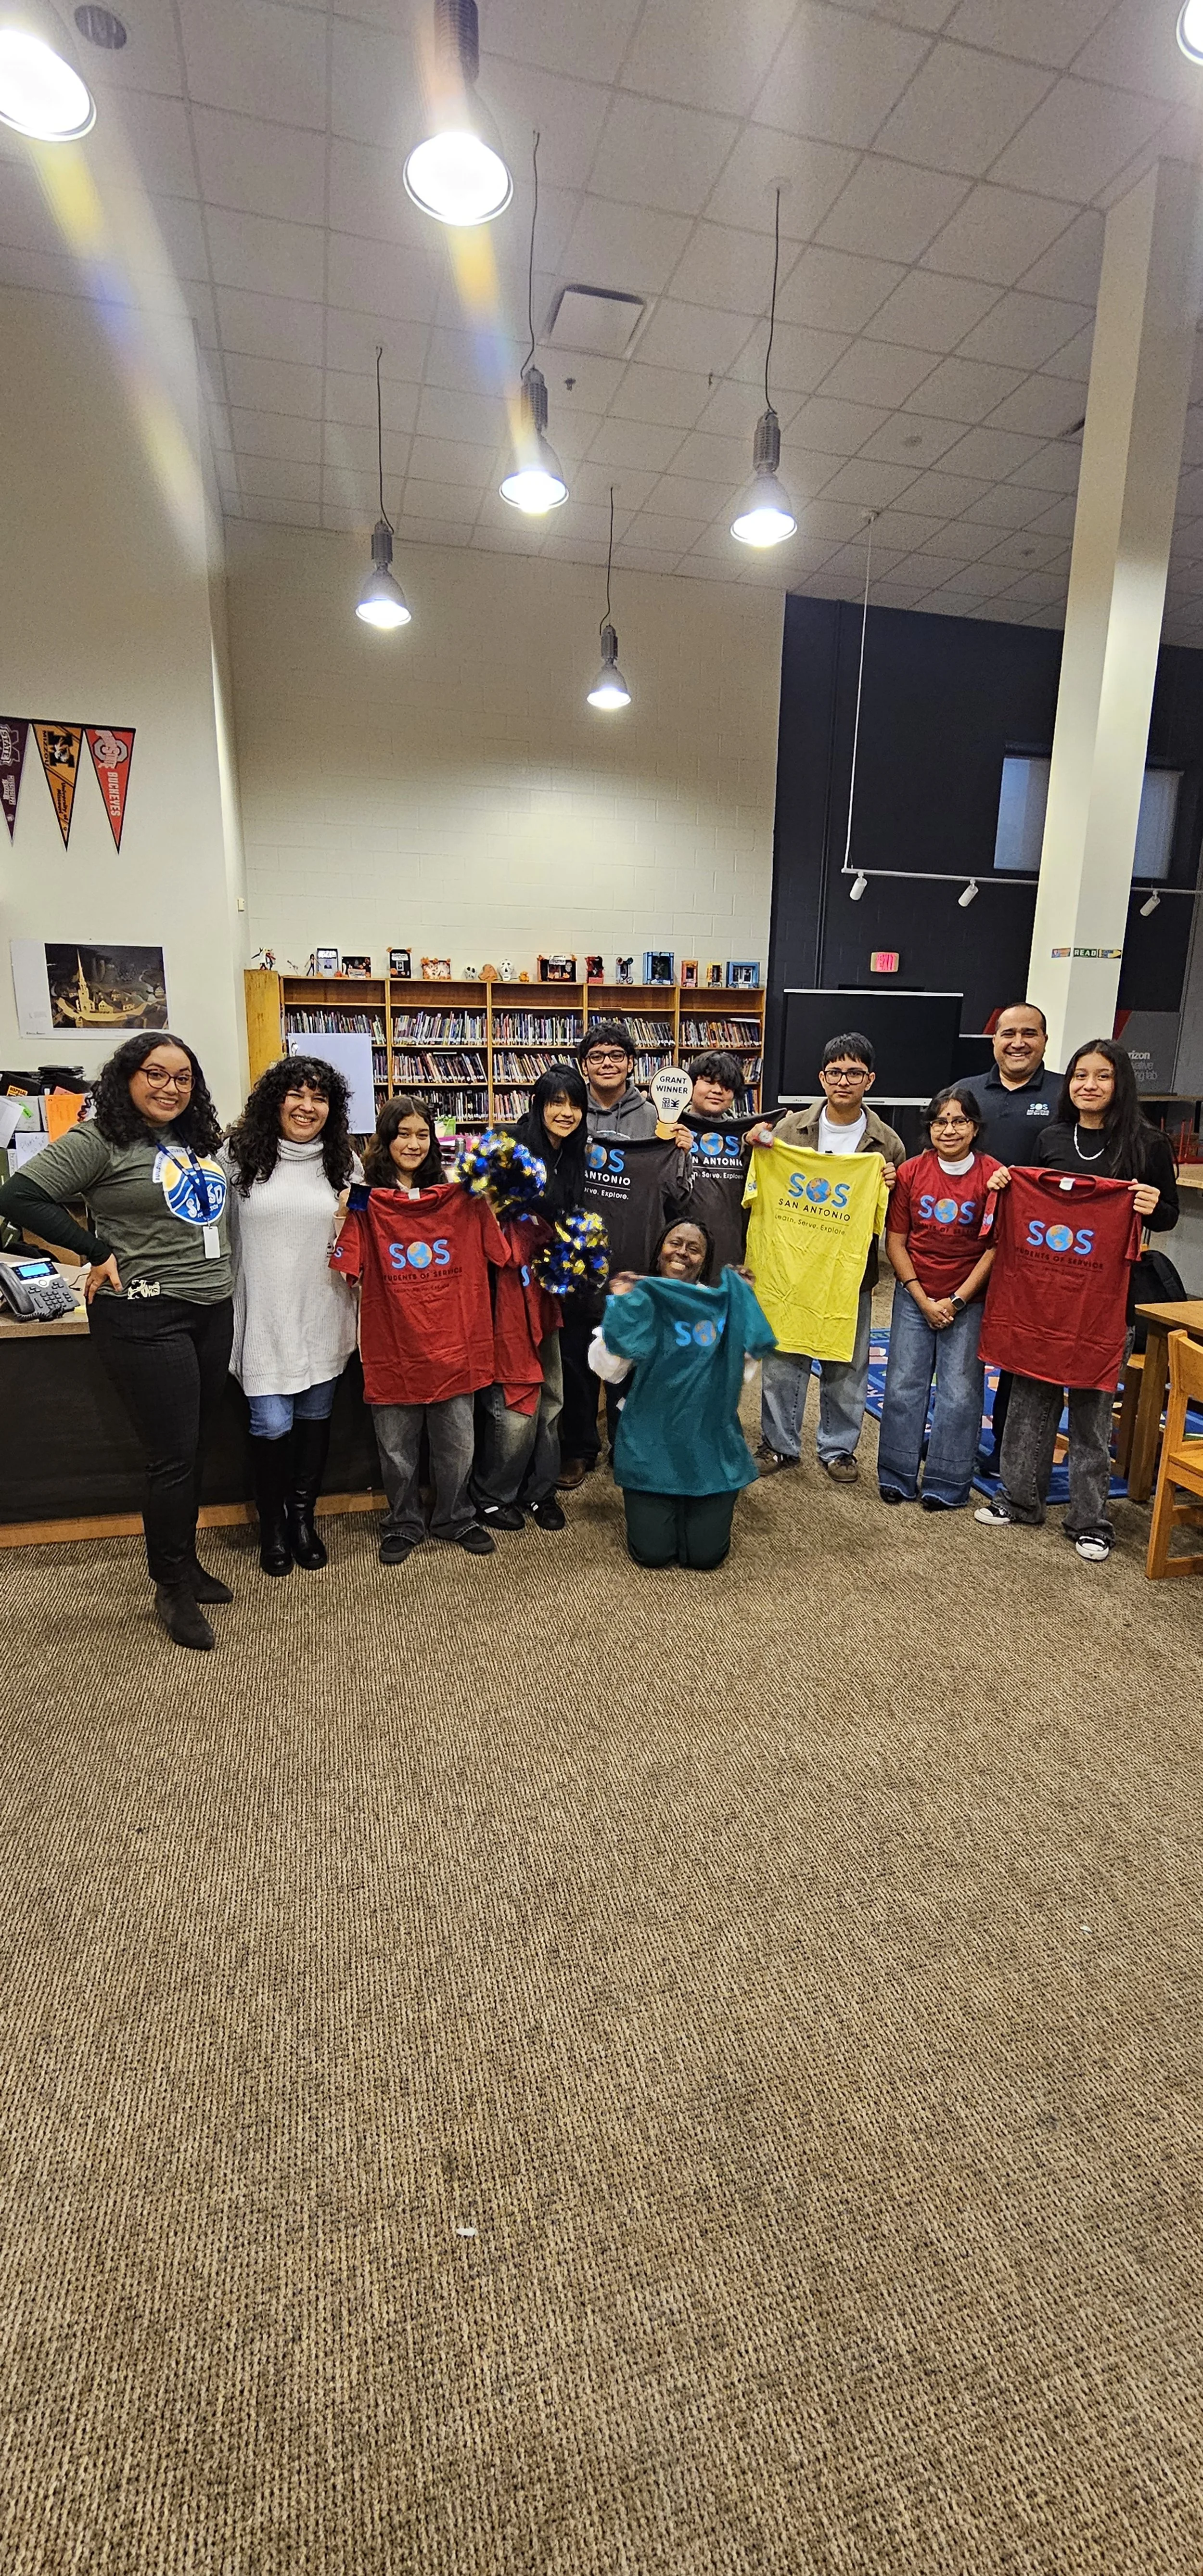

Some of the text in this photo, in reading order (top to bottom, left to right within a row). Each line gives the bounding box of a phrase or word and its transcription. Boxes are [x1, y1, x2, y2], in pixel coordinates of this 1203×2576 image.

[1, 731, 10, 758] STATE
[1127, 1050, 1150, 1060] rizon
[656, 1085, 688, 1094] WINNER
[660, 1076, 687, 1084] GRANT
[585, 1142, 625, 1172] OS
[703, 1156, 743, 1166] ANTONI
[601, 1190, 629, 1200] Explore.
[788, 1172, 851, 1208] SOS
[779, 1198, 851, 1221] SAN ANTONIO
[918, 1195, 976, 1224] SOS
[775, 1214, 846, 1235] Learn. Serve. Explore.
[1026, 1220, 1094, 1255] SOS
[388, 1239, 451, 1269] SOS
[1068, 1258, 1103, 1269] SERVICE
